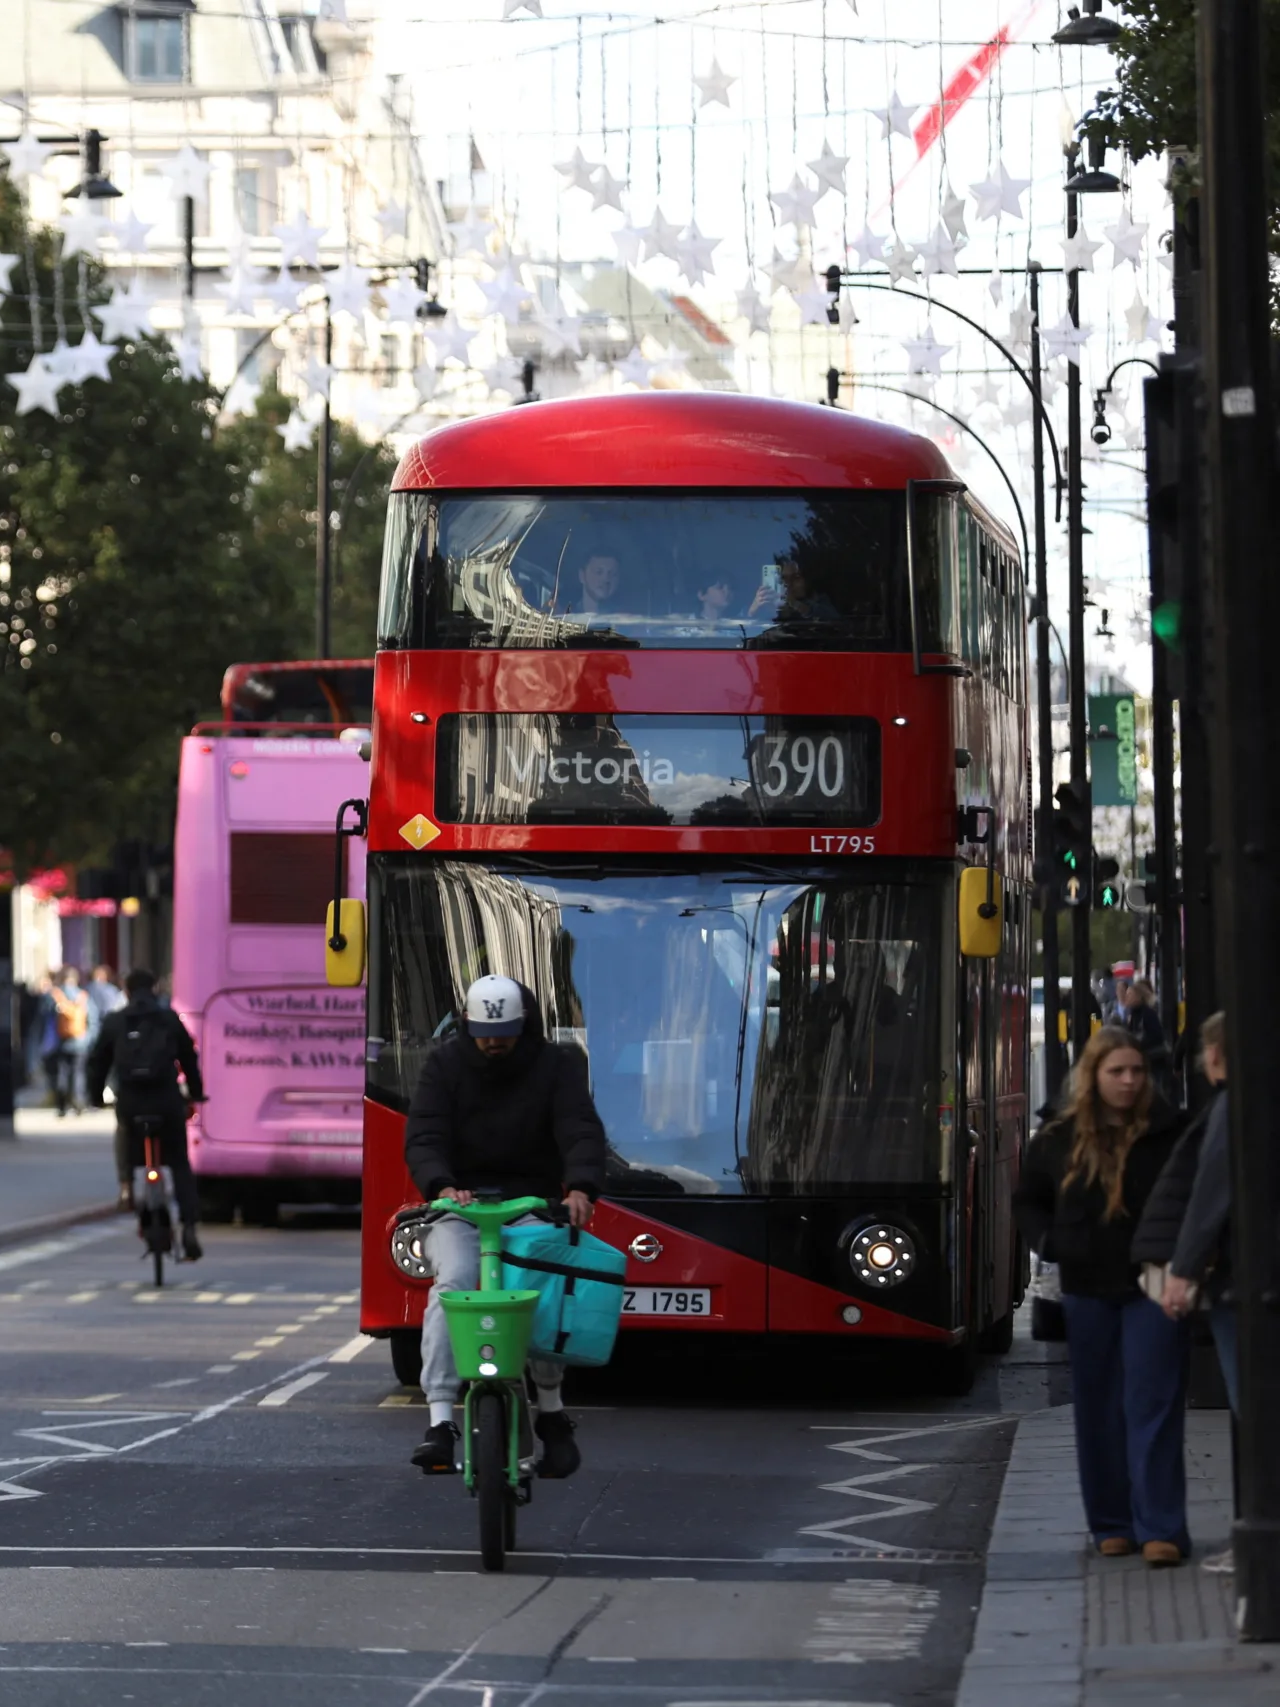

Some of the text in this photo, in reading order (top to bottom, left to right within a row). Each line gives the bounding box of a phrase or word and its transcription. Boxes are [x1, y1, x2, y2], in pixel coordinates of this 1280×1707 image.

[505, 736, 845, 797] Victoria 390
[810, 836, 875, 853] LT795
[247, 994, 321, 1012] Warhol,
[482, 998, 505, 1018] W
[652, 1292, 704, 1313] 1795
